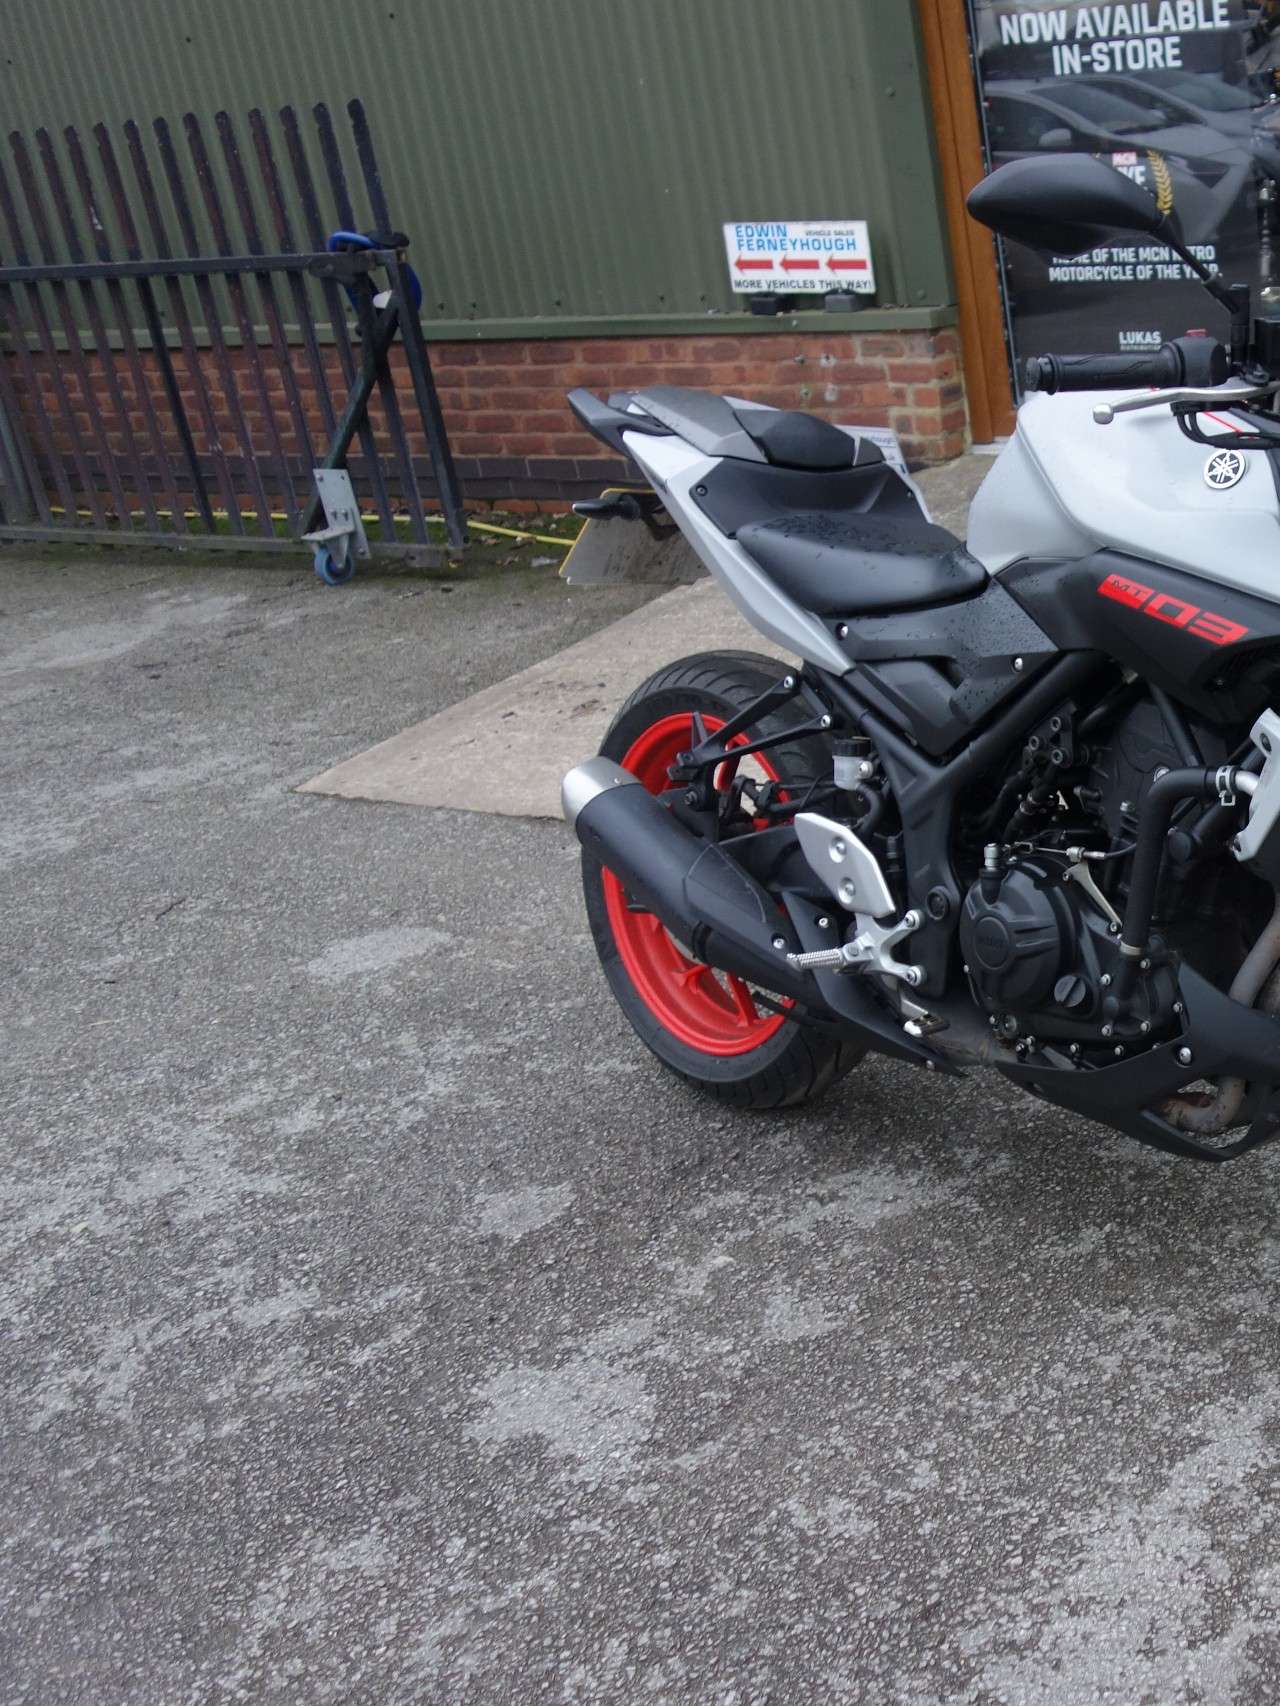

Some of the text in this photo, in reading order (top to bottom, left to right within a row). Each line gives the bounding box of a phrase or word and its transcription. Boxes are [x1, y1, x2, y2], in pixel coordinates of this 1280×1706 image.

[1000, 0, 1231, 45] NOW AVAILABLE
[1052, 36, 1183, 75] IN-STORE
[735, 224, 788, 238] EDWIN
[737, 238, 857, 251] FERNEYHOUGH
[1092, 248, 1108, 263] OF
[1111, 247, 1136, 263] THE
[1139, 246, 1169, 262] MCN
[1171, 245, 1216, 261] RTRO
[1048, 262, 1223, 281] MOTORCYCLE OF THE YR.
[734, 279, 763, 289] MORE
[766, 279, 816, 289] VEHICLES
[819, 279, 842, 289] THIS
[1119, 331, 1161, 344] LUKAS
